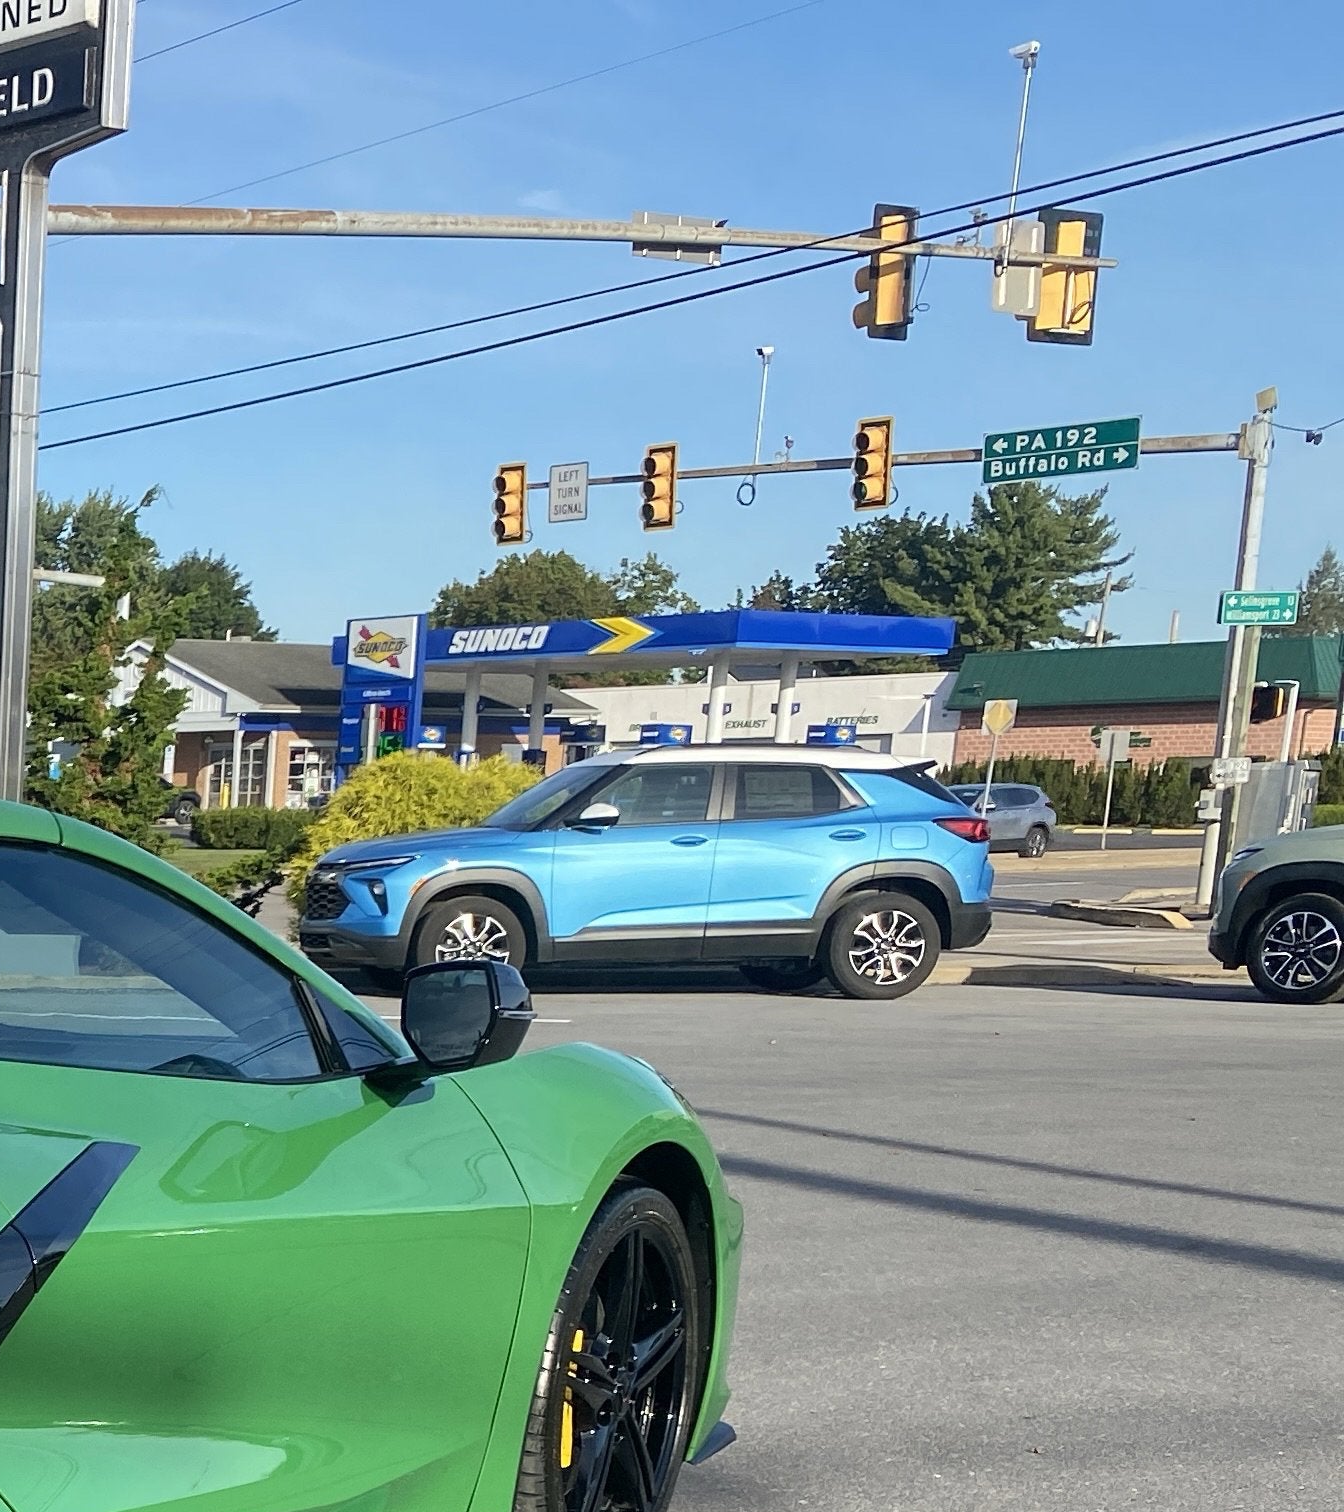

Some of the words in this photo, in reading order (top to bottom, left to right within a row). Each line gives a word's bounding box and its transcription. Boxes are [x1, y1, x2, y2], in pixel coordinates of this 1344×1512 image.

[1015, 433, 1046, 452] PA
[1055, 427, 1097, 448] 192
[990, 454, 1069, 477] Buffalo
[1077, 448, 1105, 468] Rd
[558, 469, 579, 483] LEFT
[557, 486, 580, 499] TURN
[553, 502, 583, 516] SIGNAL
[355, 638, 406, 655] SUNOCO
[448, 625, 550, 654] SUNOCO
[724, 719, 767, 729] EXHAUST
[826, 715, 878, 725] BATTERIES
